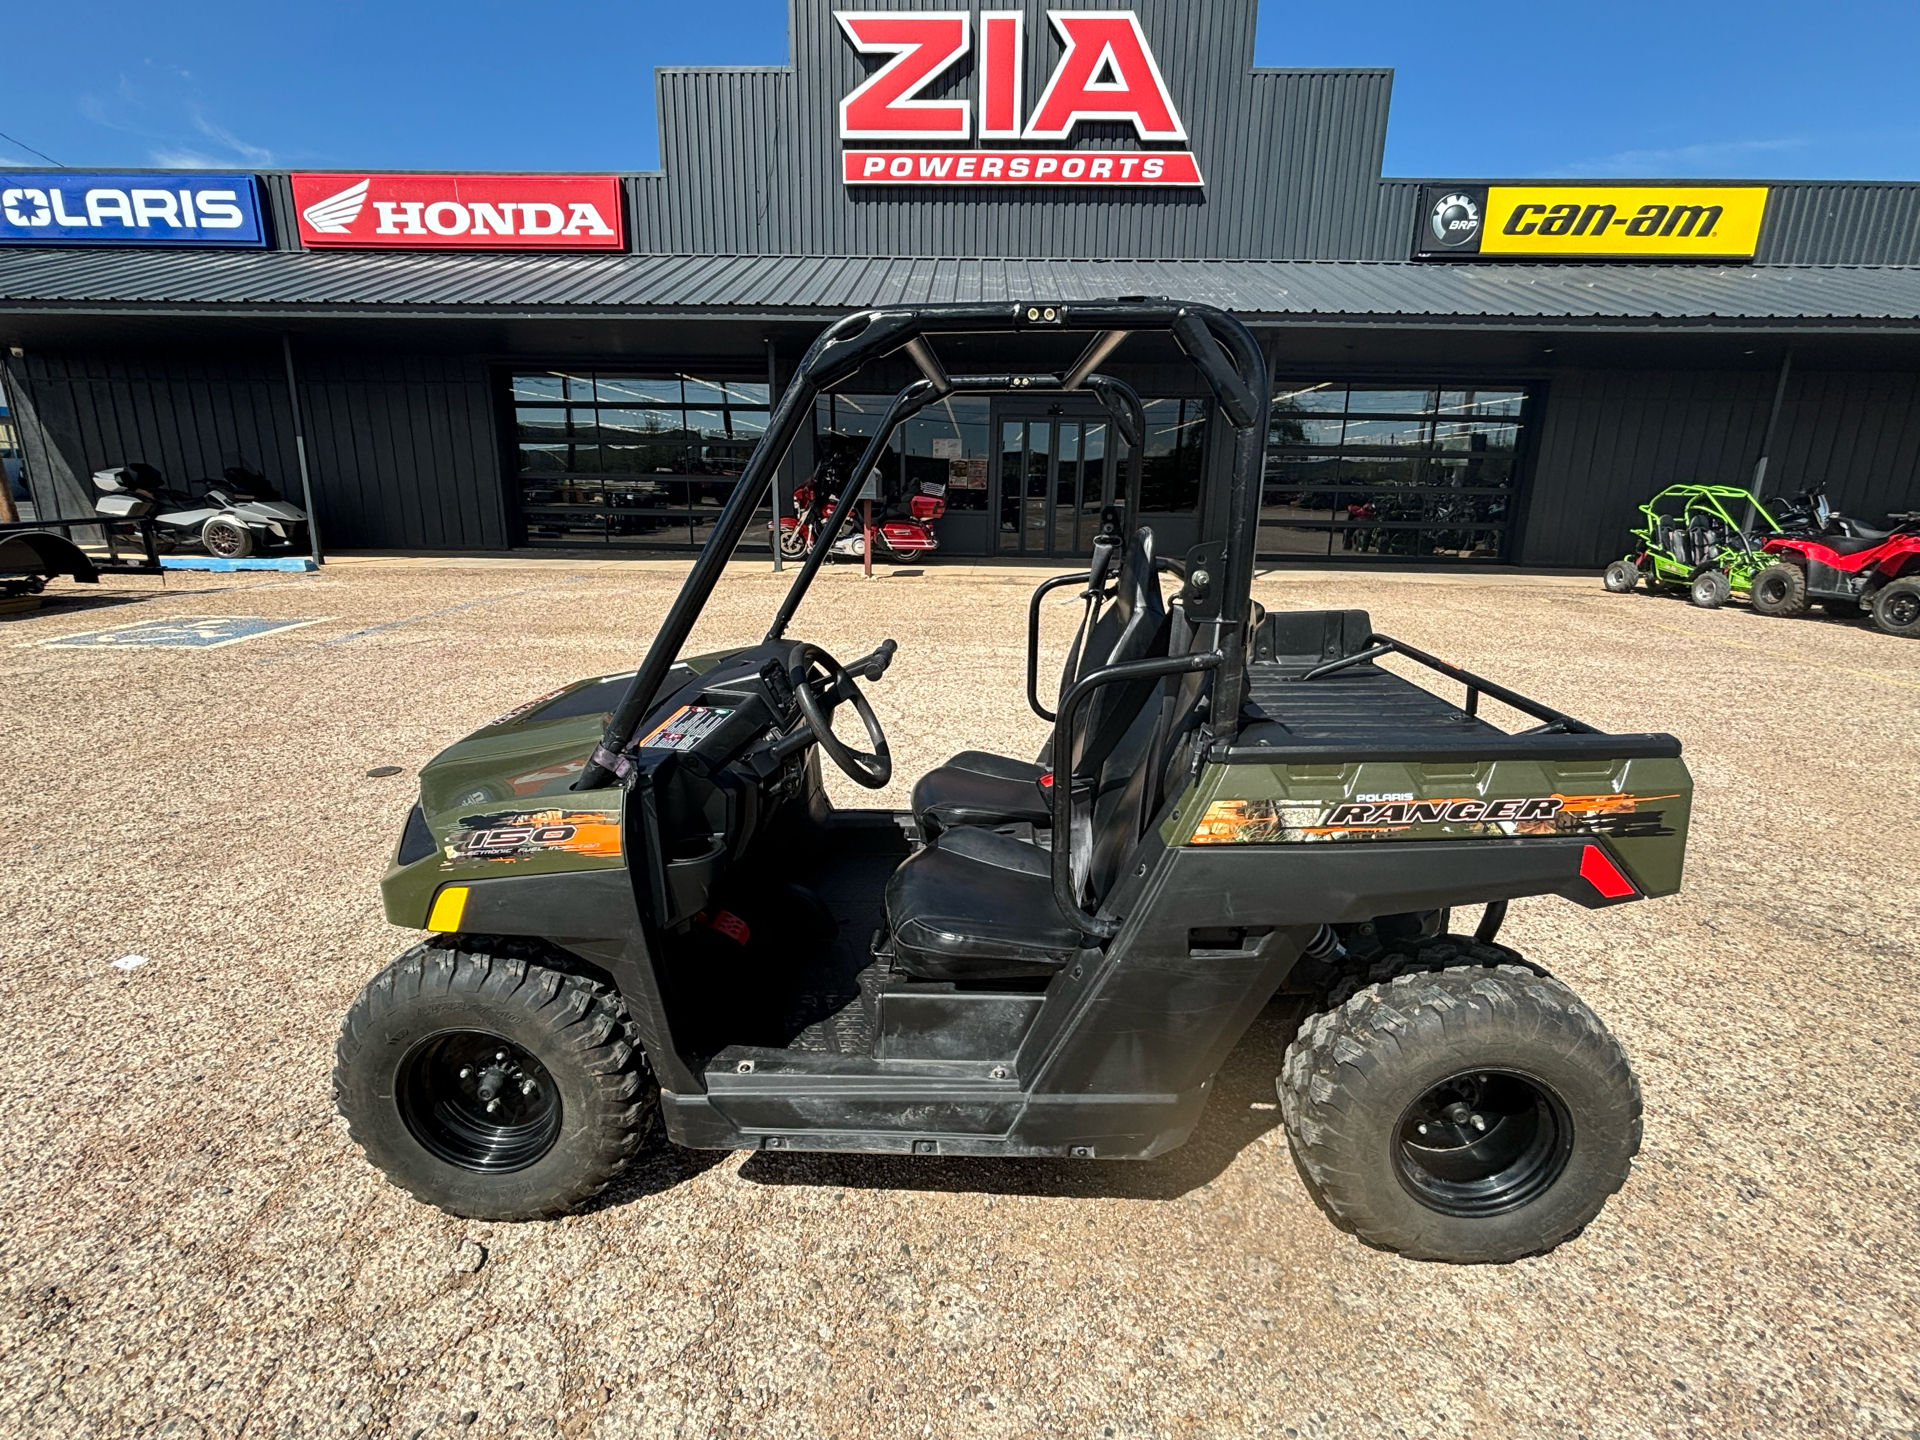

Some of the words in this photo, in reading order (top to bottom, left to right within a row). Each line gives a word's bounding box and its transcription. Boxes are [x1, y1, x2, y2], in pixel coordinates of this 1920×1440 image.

[833, 9, 1188, 141] ZIA
[863, 157, 1164, 178] POWERSPORTS
[0, 188, 243, 228] OLARIS
[373, 201, 614, 236] HONDA
[1449, 220, 1478, 230] BRP
[1356, 793, 1413, 803] POLARIS
[1327, 797, 1564, 826] RANGER
[468, 825, 577, 849] 150
[517, 846, 544, 854] FUEL
